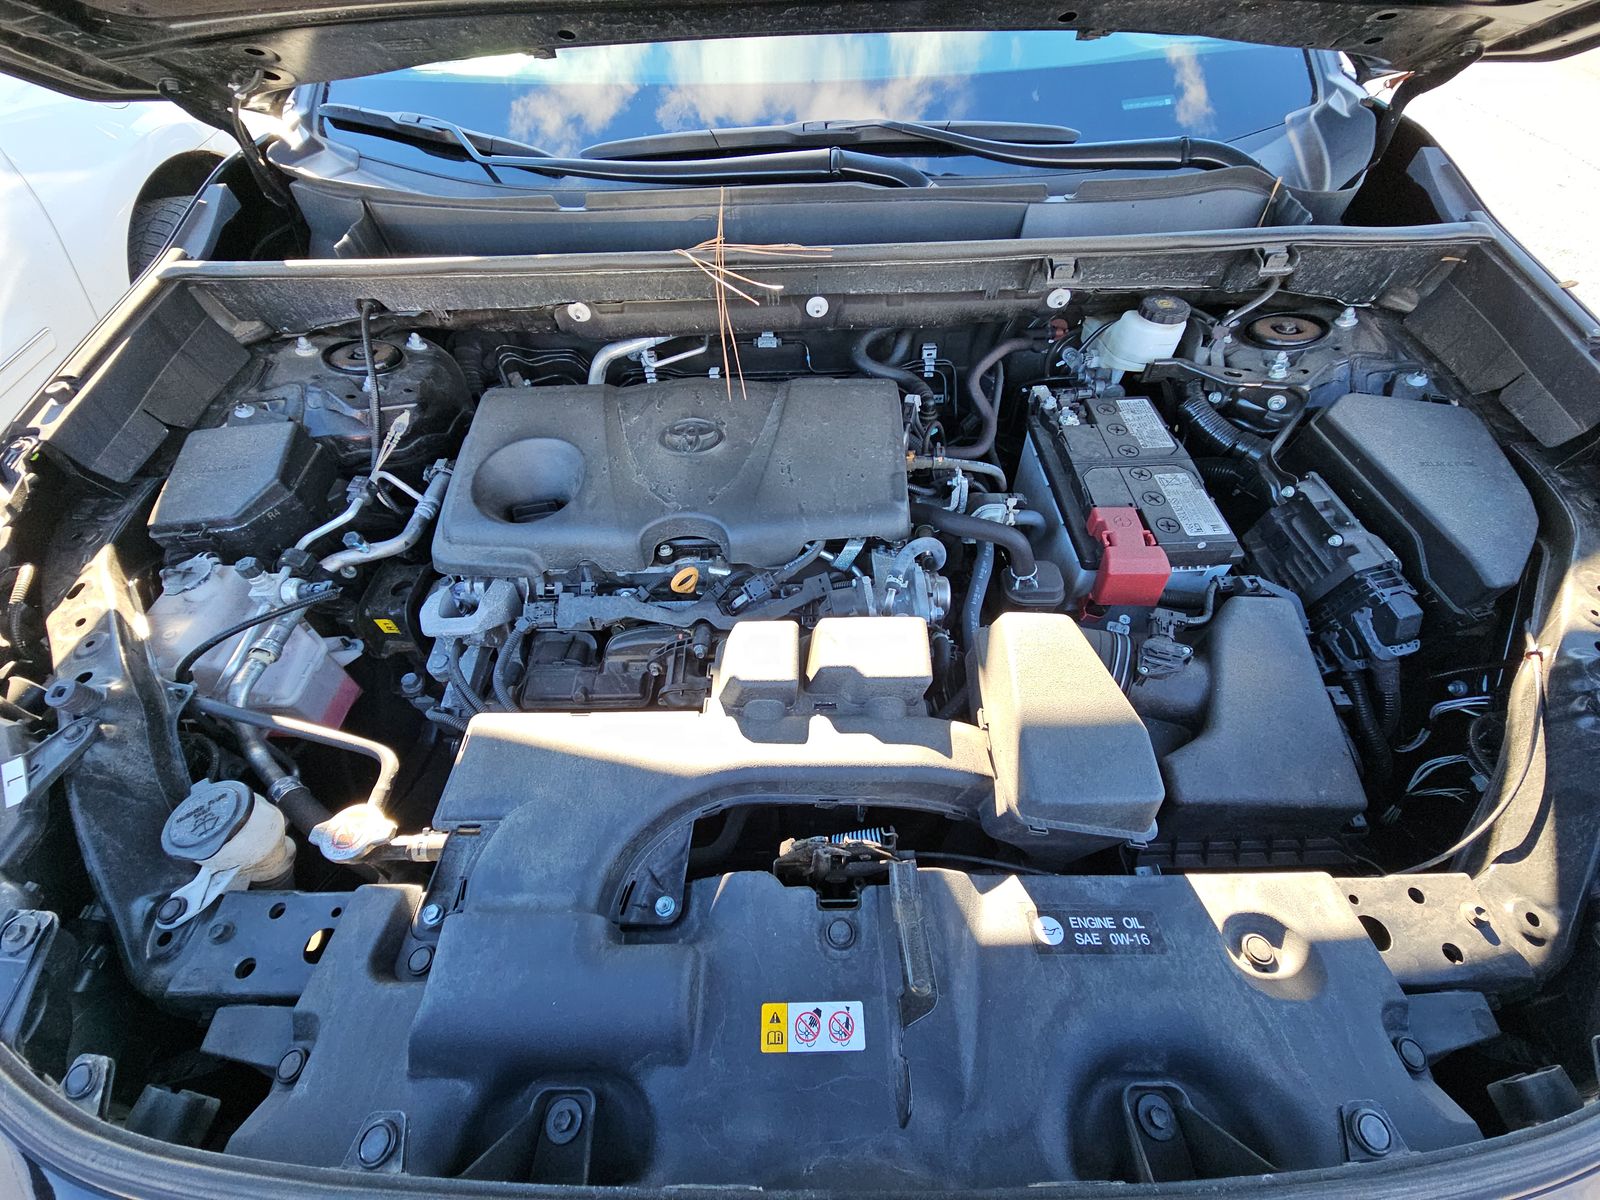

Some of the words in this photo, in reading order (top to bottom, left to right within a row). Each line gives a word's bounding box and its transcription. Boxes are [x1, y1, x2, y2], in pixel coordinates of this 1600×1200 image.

[1068, 916, 1116, 929] ENGINE
[1122, 916, 1145, 929] OIL
[1074, 932, 1102, 945] SAE
[1109, 933, 1151, 946] 0W-16
